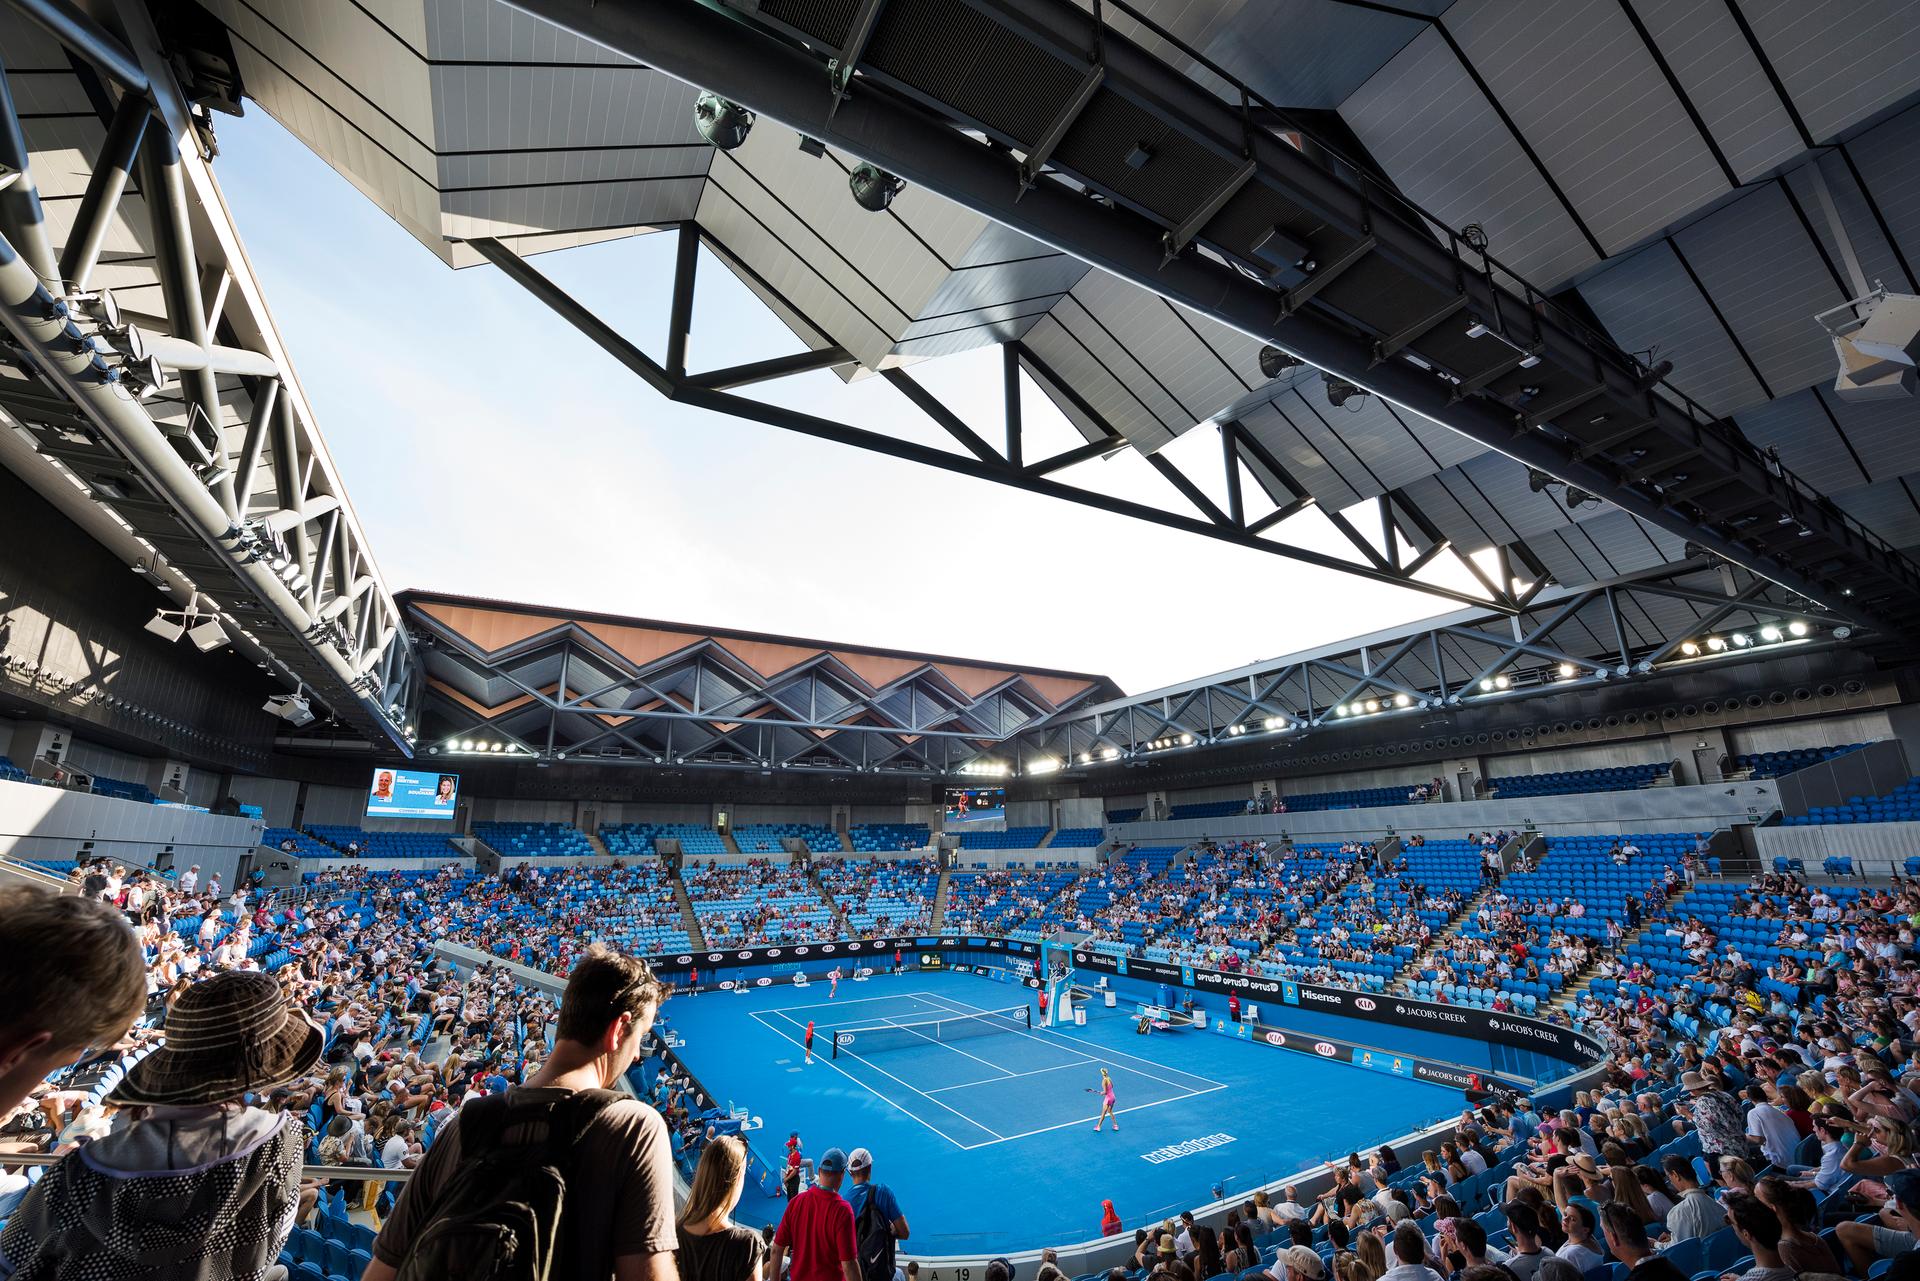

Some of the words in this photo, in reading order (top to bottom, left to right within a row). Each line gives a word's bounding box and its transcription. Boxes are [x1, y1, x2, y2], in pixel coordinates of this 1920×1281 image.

[1747, 806, 1758, 814] 15
[1197, 973, 1215, 983] OPTUS
[1222, 977, 1242, 987] OPTUS
[1250, 981, 1271, 991] OPTUS
[1301, 989, 1342, 1004] Hisense
[1406, 1007, 1438, 1019] JACOB'S
[1438, 1012, 1467, 1024] CREEK
[1501, 1021, 1534, 1037] JACOB'S
[1534, 1028, 1560, 1044] CREEK
[1427, 1069, 1453, 1081] JACOB'S
[930, 1270, 939, 1281] A
[954, 1268, 970, 1281] 19
